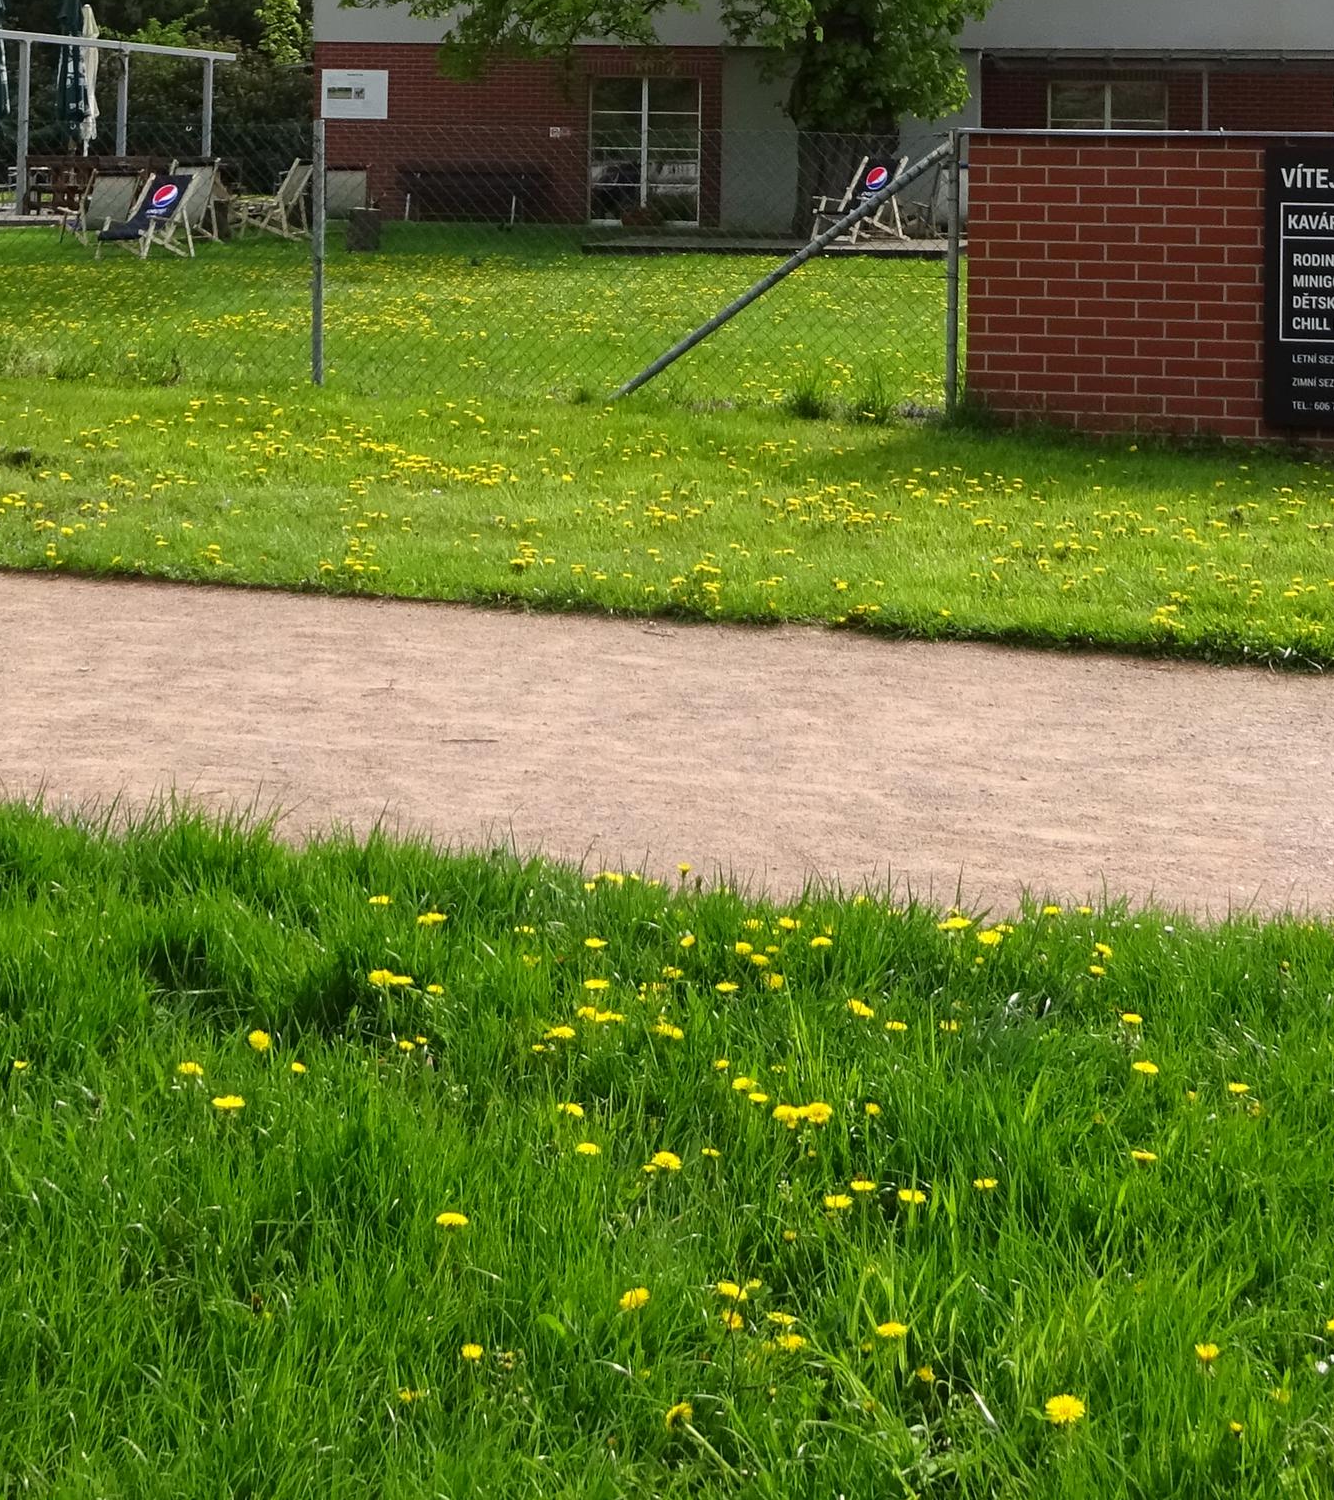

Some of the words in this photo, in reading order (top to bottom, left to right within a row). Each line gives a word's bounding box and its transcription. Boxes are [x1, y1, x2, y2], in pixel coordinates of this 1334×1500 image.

[1292, 317, 1331, 331] CHILL
[1292, 353, 1317, 364] LETNÍ
[1292, 376, 1317, 387] ZIMNÍ
[1314, 401, 1330, 411] 606
